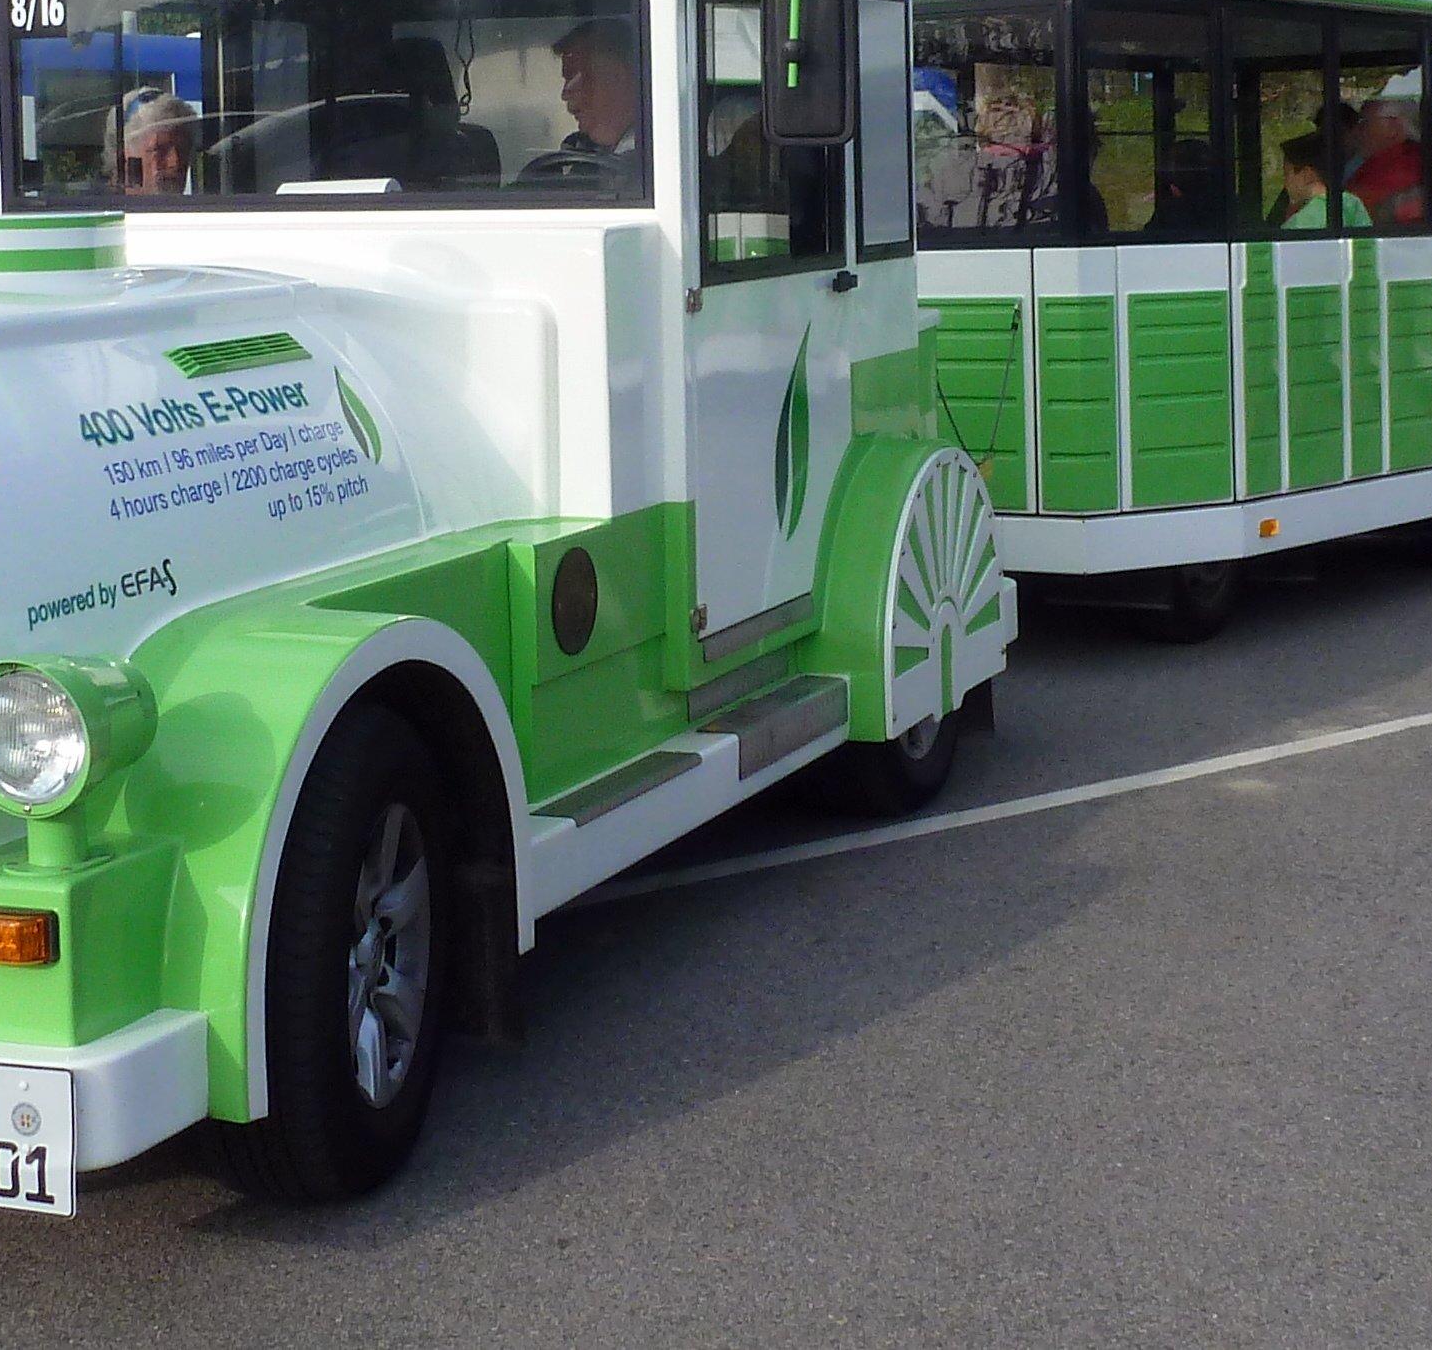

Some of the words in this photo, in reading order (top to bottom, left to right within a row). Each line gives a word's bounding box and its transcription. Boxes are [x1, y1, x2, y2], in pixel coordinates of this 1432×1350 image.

[79, 407, 134, 447] 400
[126, 396, 205, 436] Volts
[197, 381, 308, 423] E-Power
[103, 459, 135, 485] 150
[134, 457, 163, 479] km
[171, 447, 195, 470] 96
[195, 441, 235, 466] miles
[235, 437, 259, 462] per
[259, 431, 289, 453] Day
[298, 420, 344, 442] charge
[110, 498, 121, 521] 4
[121, 492, 169, 519] hours
[170, 479, 223, 505] charge
[232, 464, 267, 492] 2200
[269, 460, 316, 482] charge
[317, 446, 359, 476] cycles
[268, 498, 287, 521] up
[288, 492, 303, 513] to
[304, 482, 336, 508] 15%
[336, 474, 370, 505] pitch
[27, 584, 96, 632] powered
[98, 582, 117, 610] by
